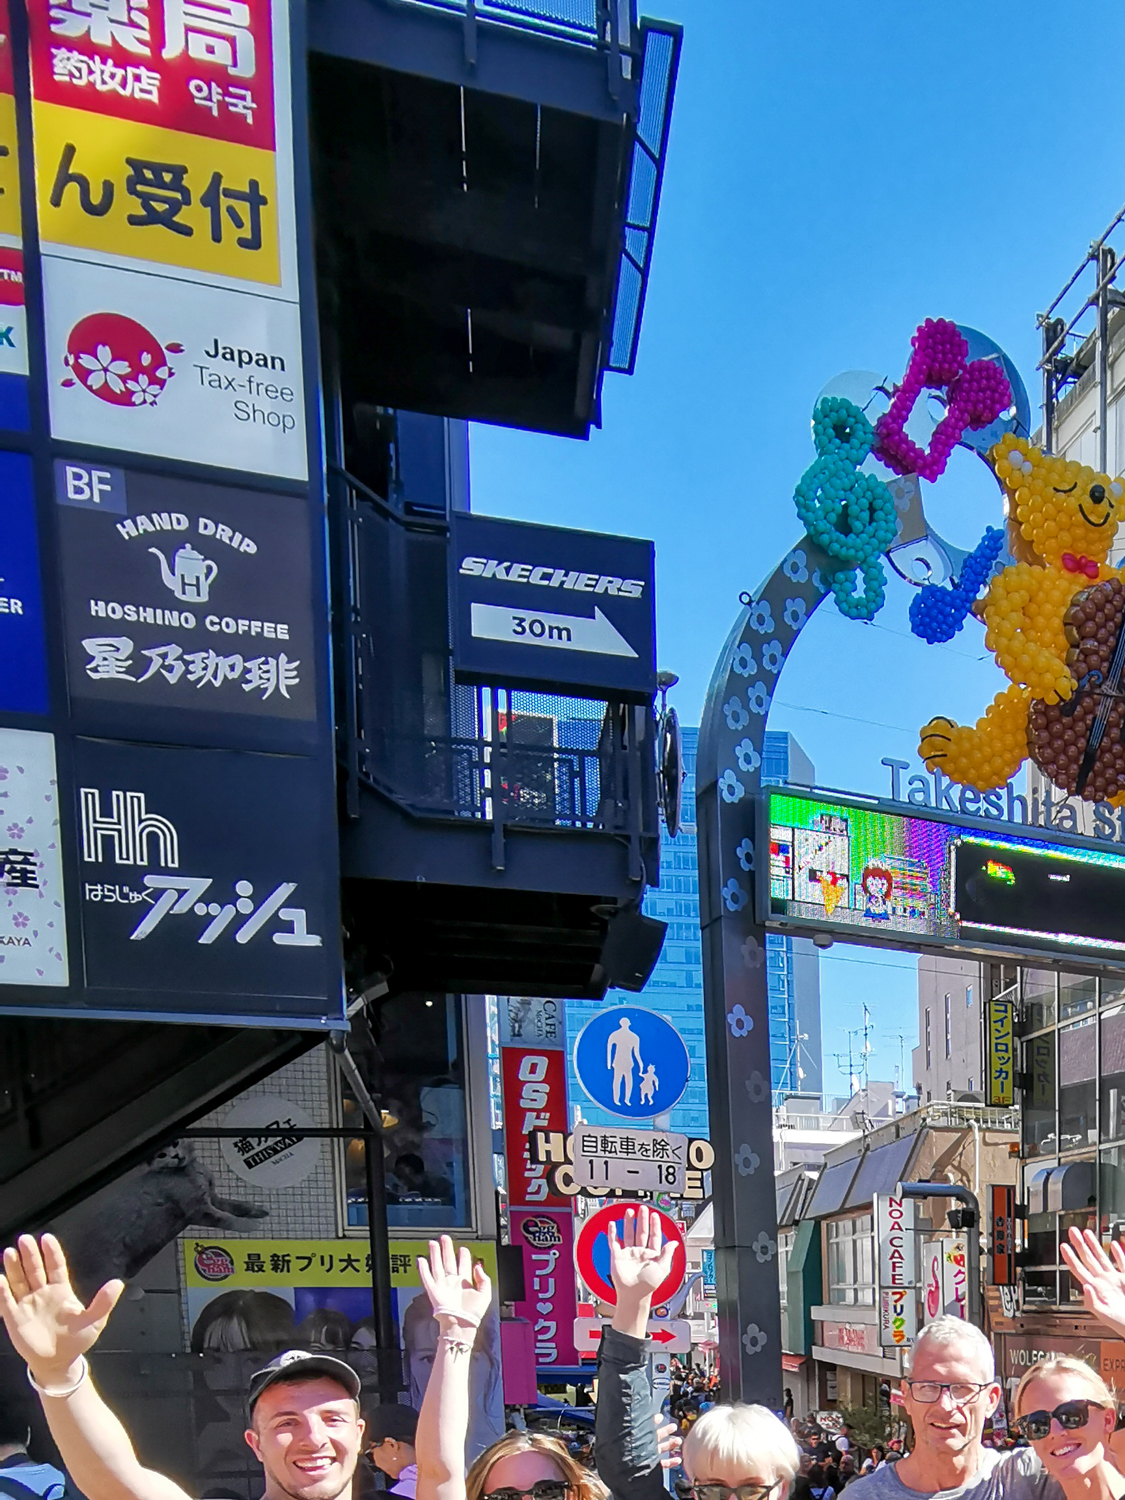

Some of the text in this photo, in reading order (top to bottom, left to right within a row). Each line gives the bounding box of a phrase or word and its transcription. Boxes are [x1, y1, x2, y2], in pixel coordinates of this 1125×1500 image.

[188, 79, 257, 124] 약국
[50, 142, 268, 250] ん受付
[205, 338, 286, 373] Japan
[193, 364, 294, 402] Tax-free
[233, 402, 296, 434] Shop
[66, 466, 111, 504] BF
[116, 512, 257, 555] HAND DRIP
[458, 556, 645, 598] SKECHERS
[90, 599, 289, 640] HOSHINO COFFEE
[511, 616, 572, 643] 30m
[82, 636, 300, 700] 星乃珈琲
[881, 757, 1077, 832] Takeshita
[993, 1003, 1011, 1093] コインロッカー
[246, 1145, 276, 1169] THIS
[582, 1134, 682, 1161] 自転車を除く
[588, 1159, 609, 1181] 11
[657, 1164, 676, 1185] 18
[889, 1197, 905, 1285] NOA CAFE
